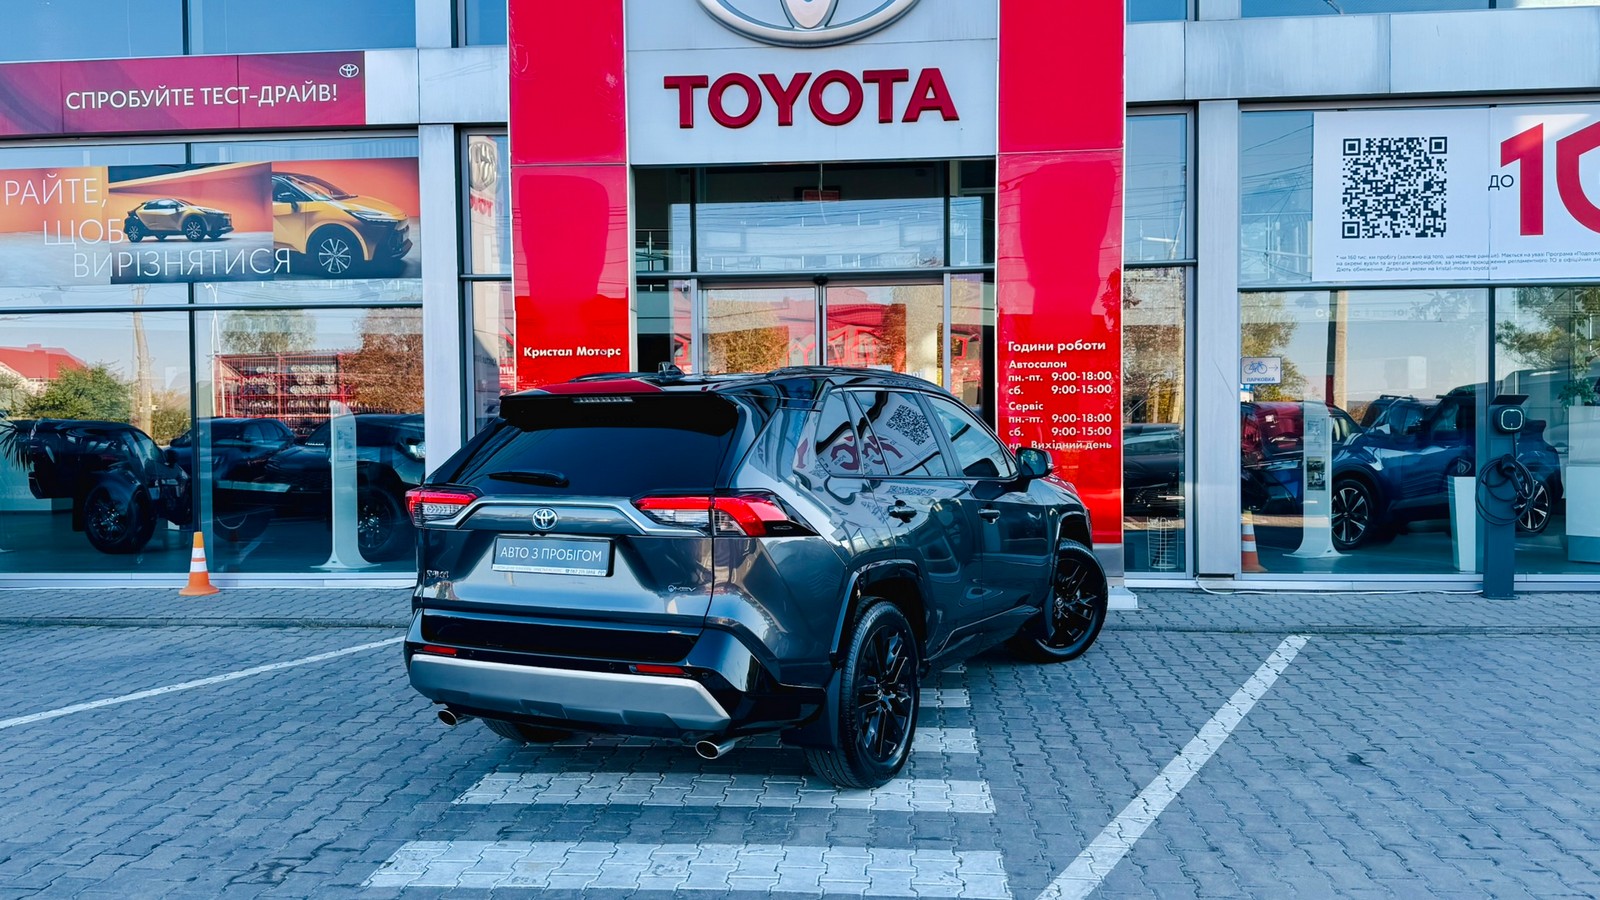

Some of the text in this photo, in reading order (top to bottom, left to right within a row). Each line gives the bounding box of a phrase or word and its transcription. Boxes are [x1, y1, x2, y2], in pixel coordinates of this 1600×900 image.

[65, 79, 339, 110] СПРОБУЙТЕ ТЕСТ-ДРАЙВ!
[663, 67, 960, 129] TOYOTA
[4, 173, 107, 208] РАЙТЕ,
[43, 218, 124, 250] ЩОБ
[74, 248, 292, 279] ВИРІЗНЯТИСЯ
[523, 346, 621, 359] Кристал Моторс
[1008, 339, 1106, 354] Години роботи
[1009, 360, 1067, 369] Автосалон
[1008, 371, 1112, 382] пн.-пт. 9:00-18:00
[1008, 384, 1112, 395] сб. 9:00-15:00
[1008, 401, 1044, 412] Сервіс
[1008, 413, 1112, 424] пн.-пт. 9:00-18:00
[1008, 426, 1112, 437] сб. 9:00-15:00
[1031, 439, 1084, 451] Вихідний
[1085, 441, 1112, 451] день
[500, 546, 529, 559] АВТО
[541, 548, 602, 562] ПРОБІГОМ
